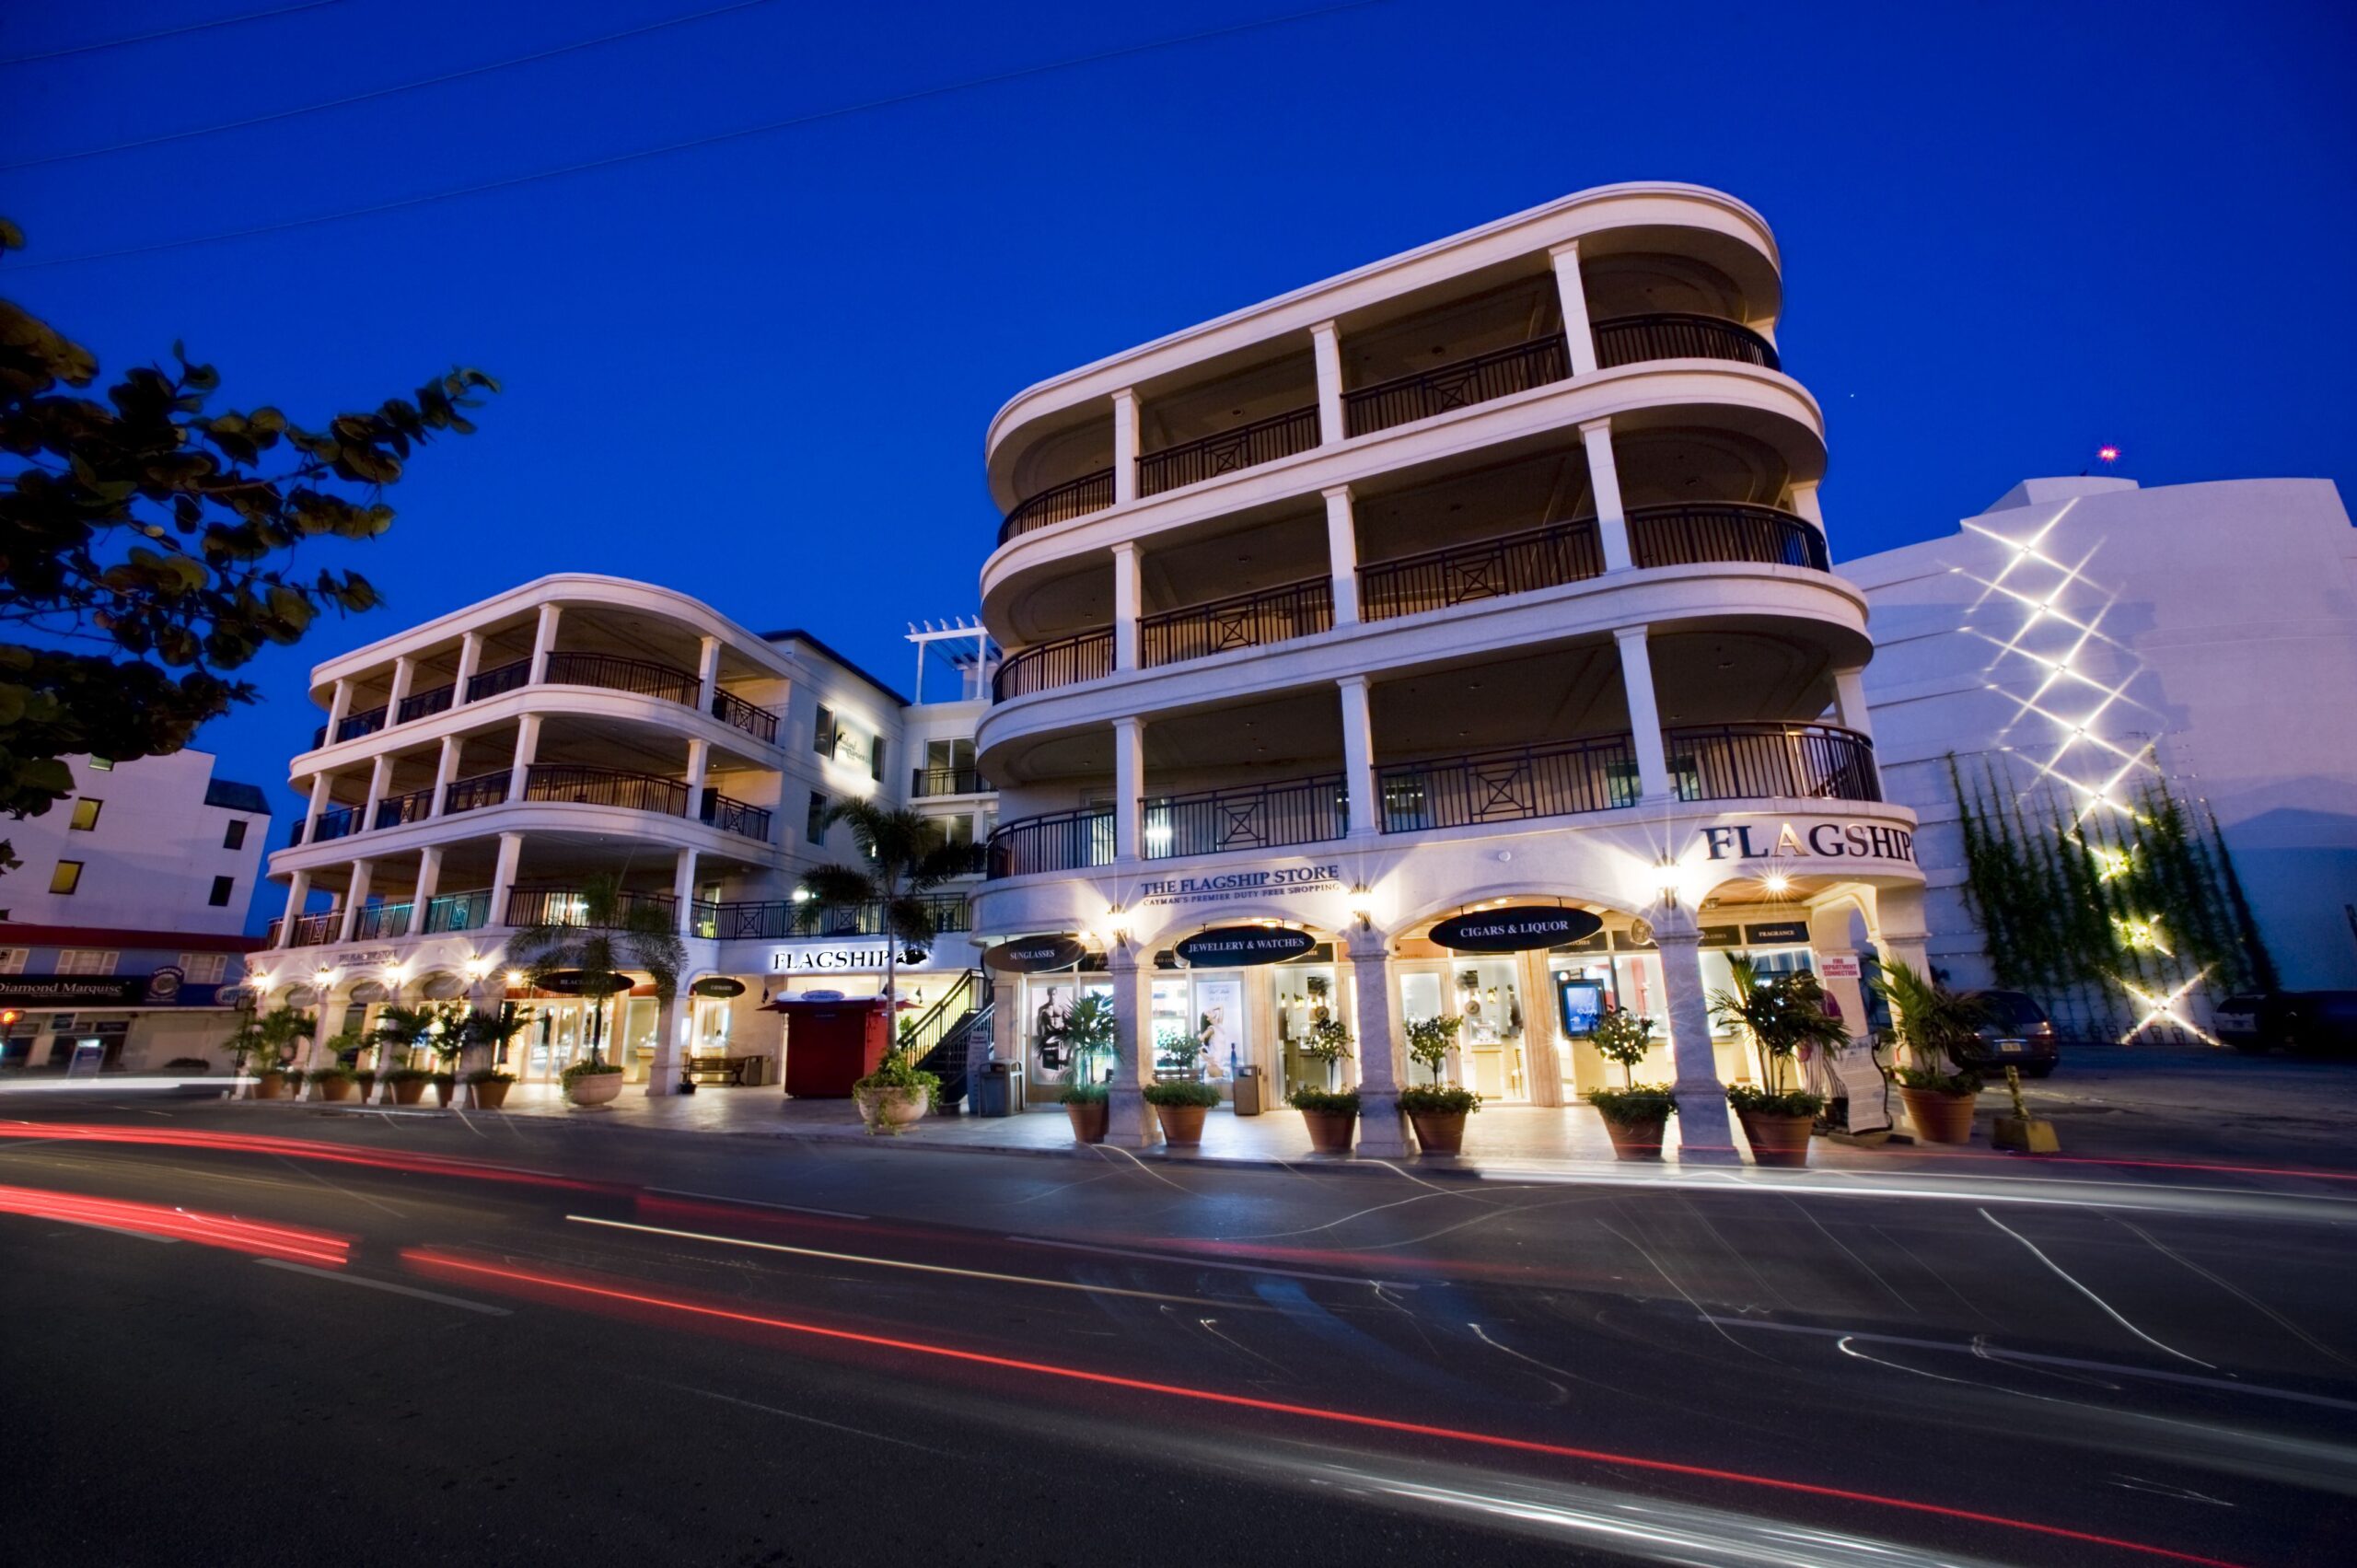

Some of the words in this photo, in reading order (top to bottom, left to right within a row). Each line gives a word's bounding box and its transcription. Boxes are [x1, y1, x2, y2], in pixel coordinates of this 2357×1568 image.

[1701, 822, 1911, 862] FLAGSHIP
[1142, 880, 1177, 895] THE
[1180, 872, 1270, 892] FLAGSHIP
[1273, 865, 1339, 883] STORE
[1144, 896, 1188, 906] CAYMAN'S
[1191, 893, 1230, 902] PREMIER
[1234, 890, 1259, 900] DUTY
[1262, 888, 1284, 897] FREE
[1287, 884, 1340, 894] SHOPPING
[1459, 925, 1505, 937] CIGARS
[1507, 924, 1517, 934] &
[1520, 921, 1569, 934] LIQUOR
[1188, 941, 1245, 953] JEWELLERY
[1247, 941, 1254, 949] &
[1256, 937, 1305, 949] WATCHES
[773, 950, 890, 970] FLAGSHIP
[1010, 949, 1055, 960] SUNGLASSES
[63, 982, 122, 994] Marquise
